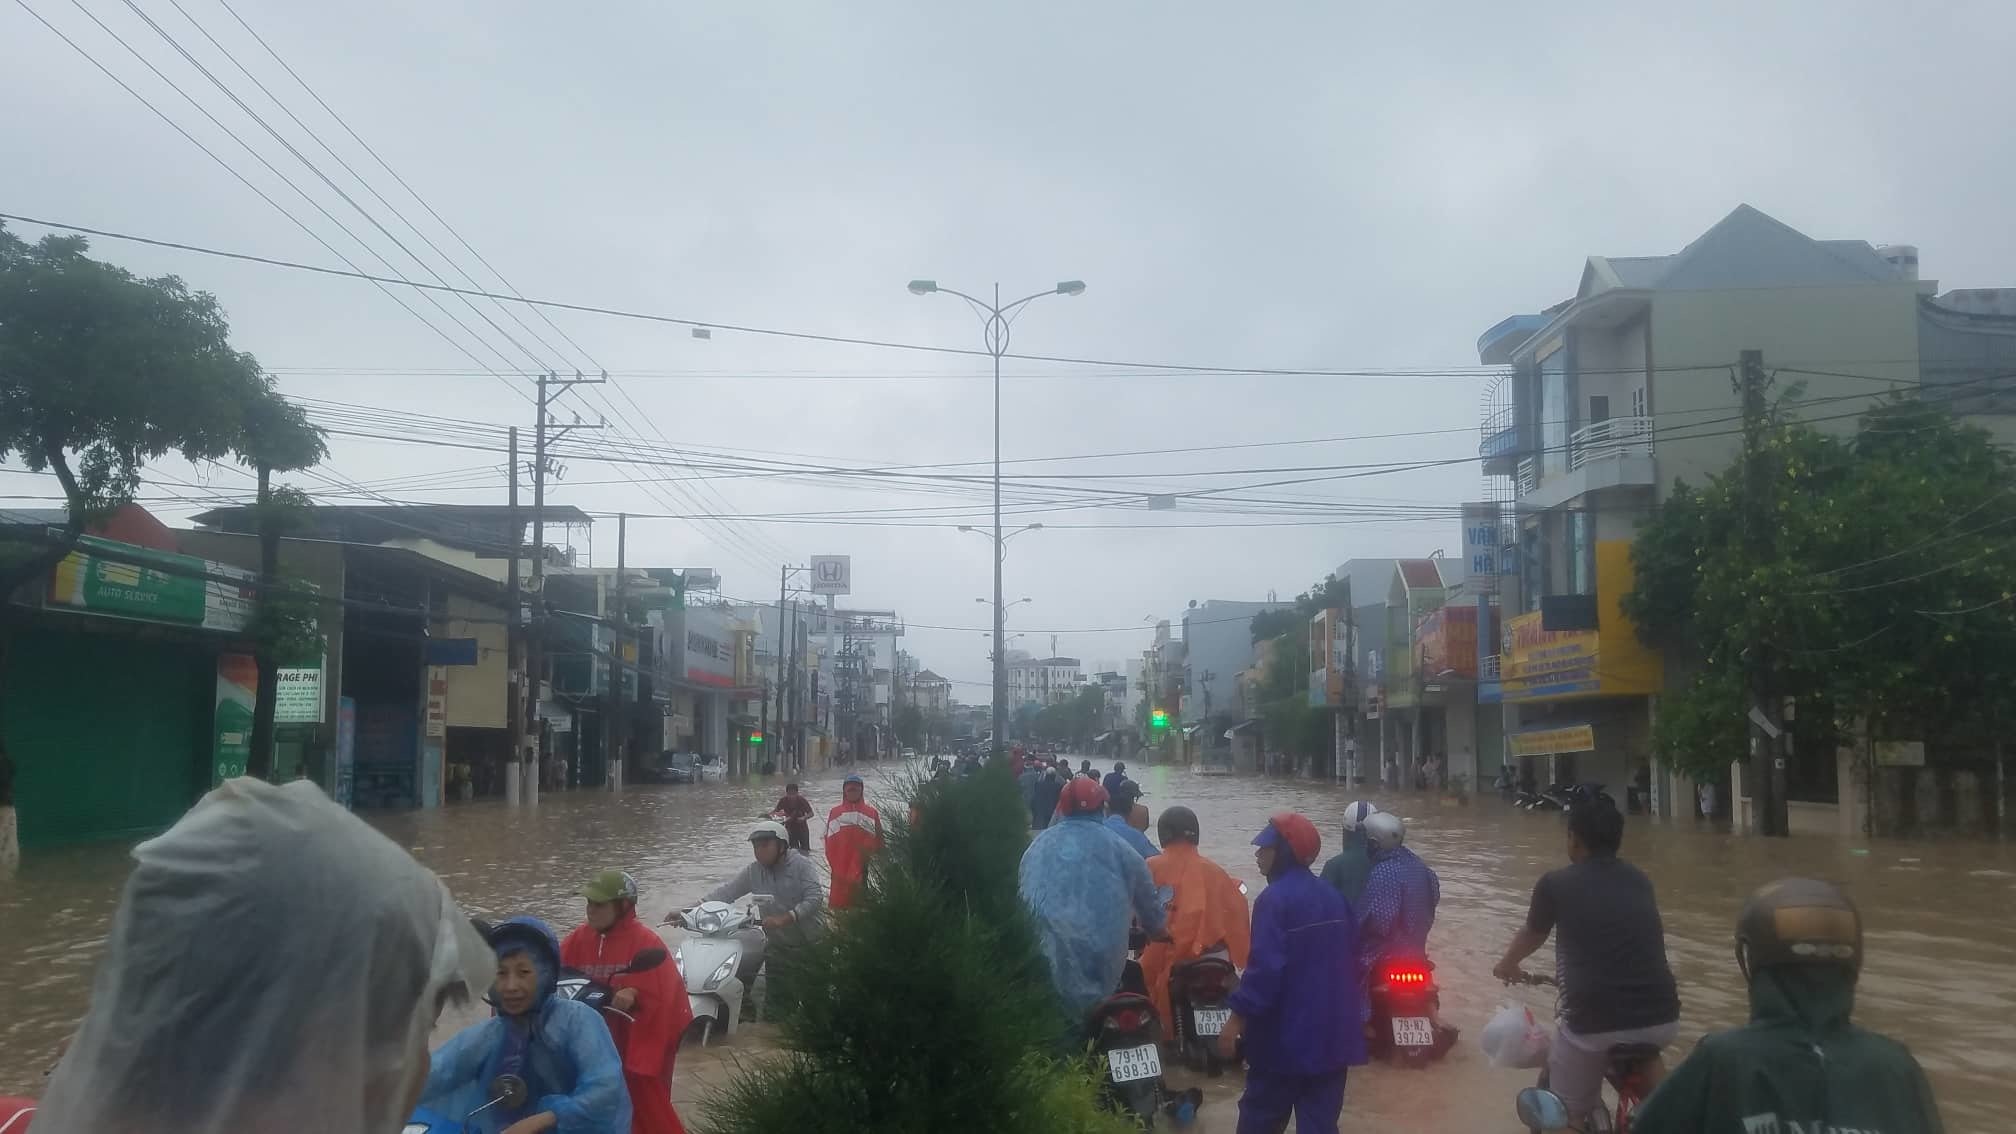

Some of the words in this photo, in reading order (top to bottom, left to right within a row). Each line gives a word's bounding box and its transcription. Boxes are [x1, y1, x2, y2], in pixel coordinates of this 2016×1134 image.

[97, 585, 122, 599] AUTO
[123, 589, 158, 602] SERVICE
[1396, 1031, 1431, 1044] 397.29
[1115, 1047, 1150, 1065] 79-H1
[1114, 1060, 1158, 1080] 698.30
